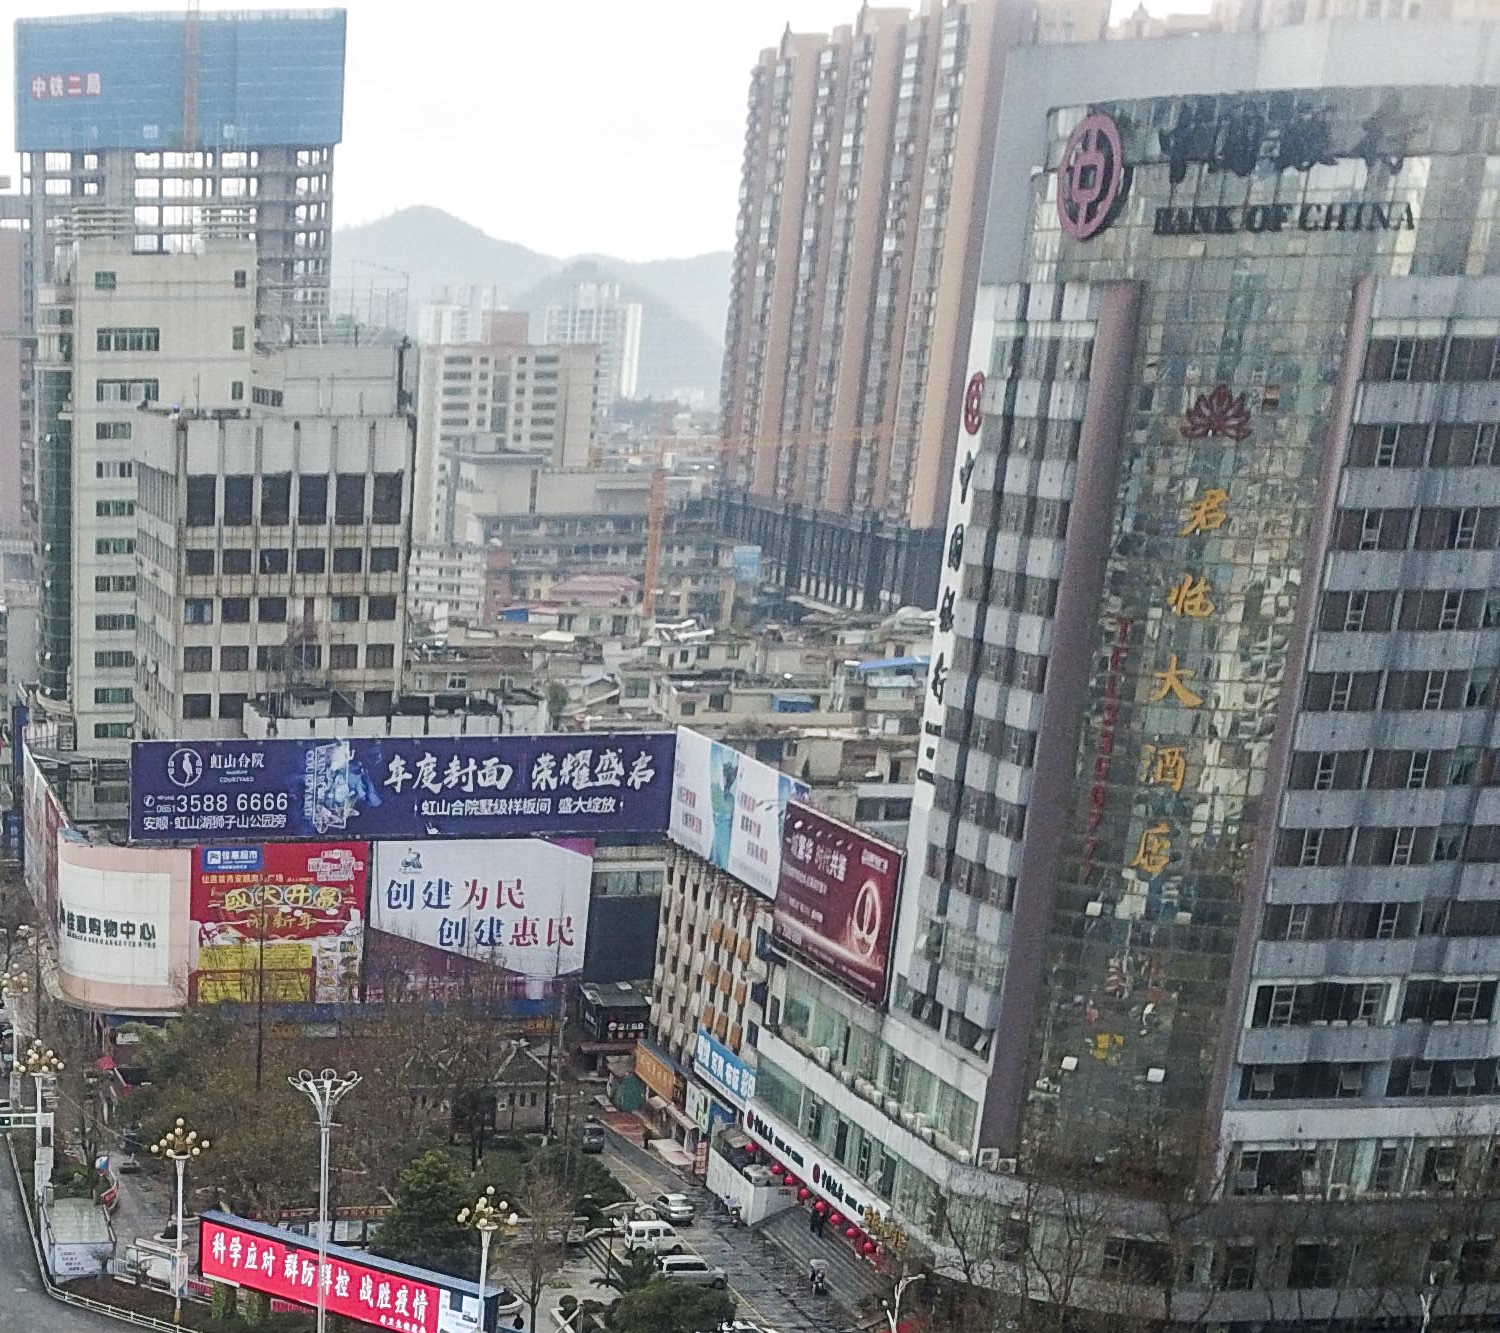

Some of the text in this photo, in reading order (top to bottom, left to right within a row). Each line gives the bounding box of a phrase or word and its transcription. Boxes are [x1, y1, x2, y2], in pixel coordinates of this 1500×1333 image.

[1153, 201, 1414, 234] BANK OF CHINA
[1130, 487, 1230, 875] 君临大酒店
[210, 753, 265, 768] 虹山合院
[384, 748, 655, 793] 年度封面 荣耀盛启
[176, 795, 228, 812] 3588
[237, 793, 288, 811] 6666
[558, 797, 616, 814] 盛大绽放
[387, 878, 525, 910] 创建为民
[438, 916, 575, 947] 创建惠民
[212, 1232, 428, 1324] 科学应对 群防群控 战胜疫情
